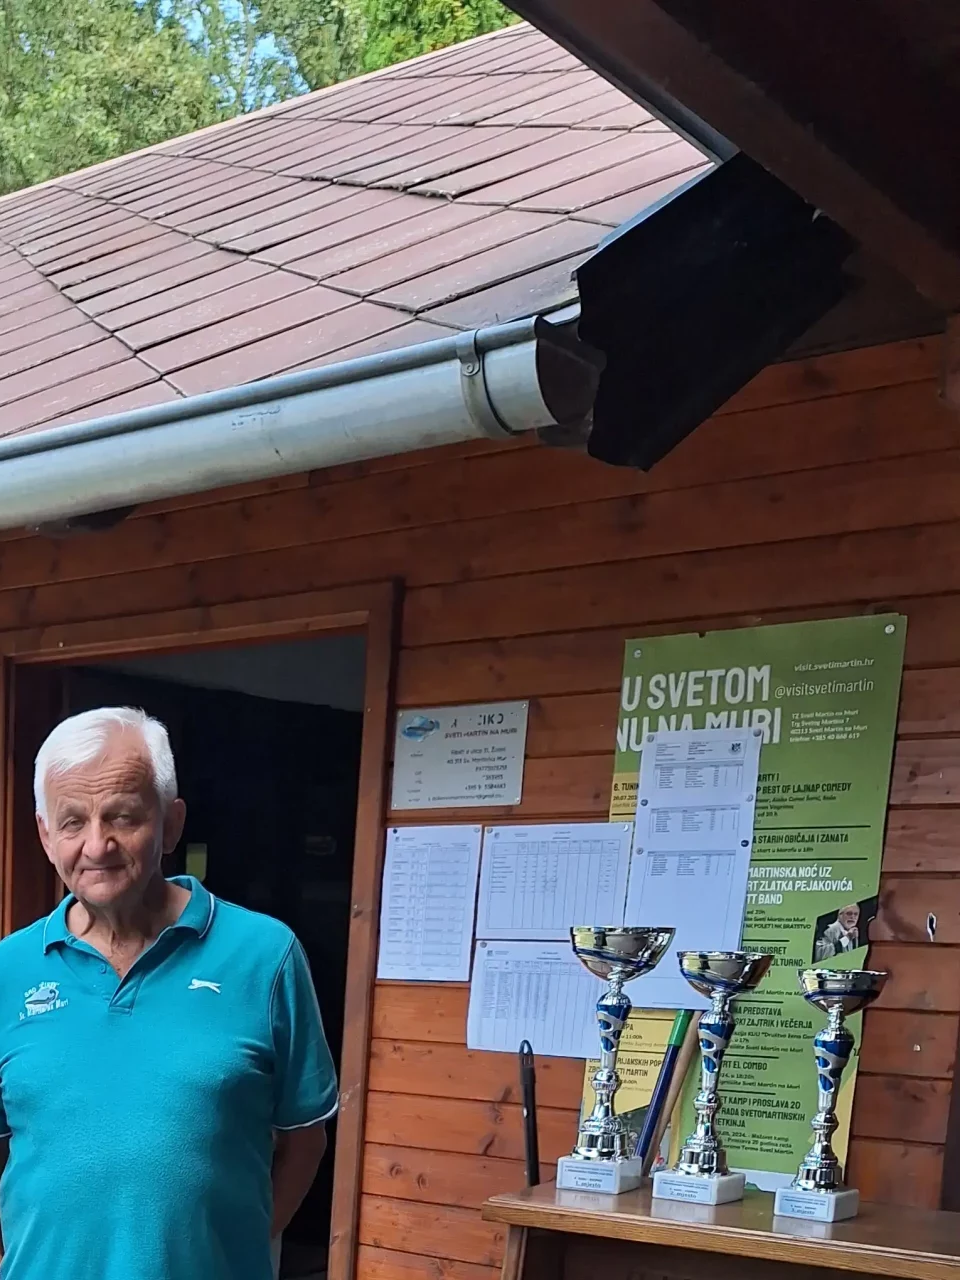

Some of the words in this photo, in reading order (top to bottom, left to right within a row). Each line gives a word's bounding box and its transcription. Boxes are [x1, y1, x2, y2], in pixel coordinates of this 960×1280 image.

[794, 658, 874, 672] visit.svetimartin.hr
[621, 676, 643, 712] U
[646, 664, 771, 710] SVETOM
[774, 678, 874, 699] @visitsvetimartin
[762, 784, 781, 795] BEST
[781, 784, 792, 793] OF
[821, 782, 852, 792] COMEDY
[758, 835, 784, 844] STARIH
[784, 832, 815, 843] OBIČAJA
[820, 833, 849, 843] ZANATA
[799, 863, 818, 878] NOĆ
[819, 866, 833, 878] UZ
[760, 880, 795, 891] ZLATKA
[795, 877, 853, 892] PEJAKOVIĆA
[759, 893, 783, 905] BAND
[760, 946, 787, 955] SUSRET
[743, 1006, 782, 1016] PREDSTAVA
[746, 1018, 775, 1028] ZAJTRIK
[780, 1017, 813, 1029] VEČERJA
[626, 1068, 649, 1077] MARTIN
[742, 1061, 768, 1071] COMBO
[728, 1097, 748, 1106] KAMP
[752, 1098, 789, 1109] PROSLAVA
[790, 1101, 801, 1110] 20
[721, 1107, 740, 1117] RADA
[740, 1108, 806, 1121] SVETOMARTINSKIH
